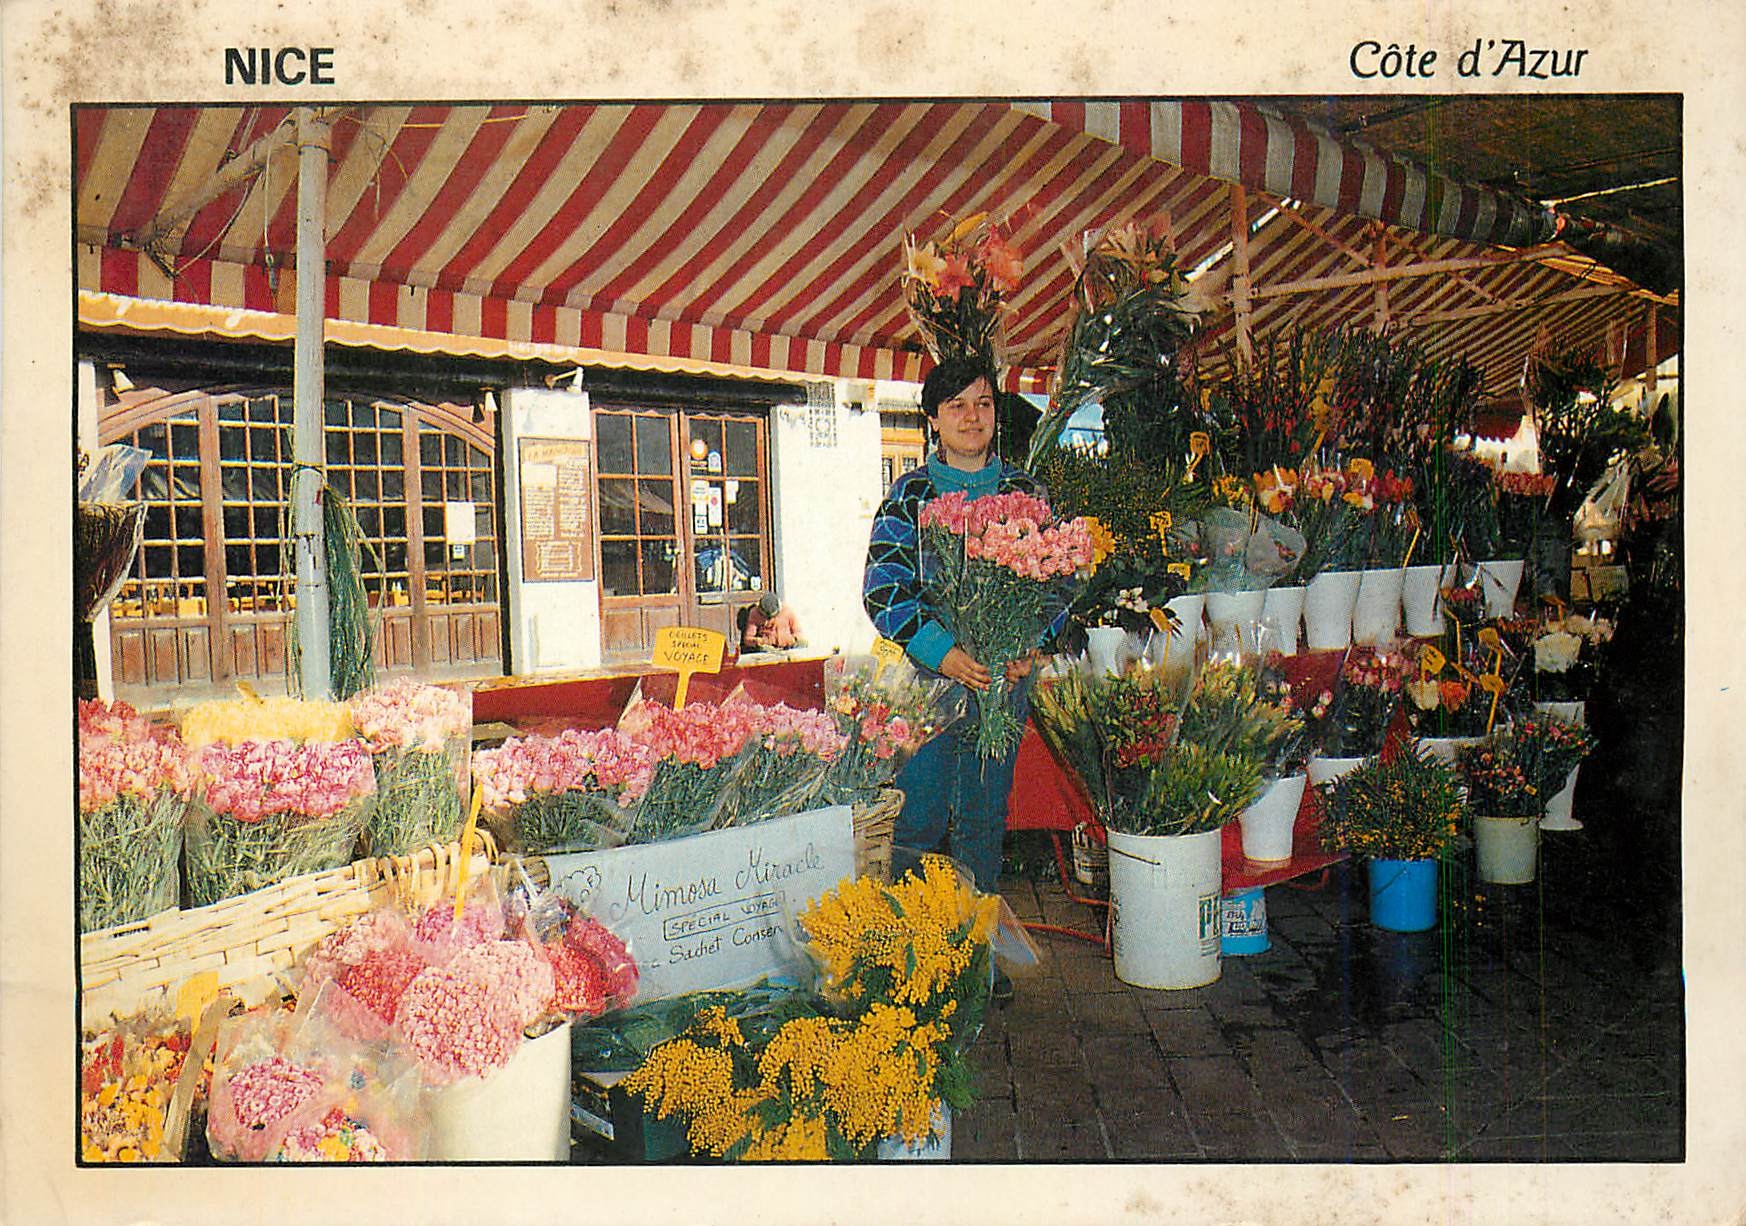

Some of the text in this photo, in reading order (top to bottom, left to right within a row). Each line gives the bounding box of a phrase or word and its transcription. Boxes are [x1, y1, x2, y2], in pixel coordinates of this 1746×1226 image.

[663, 651, 709, 664] VOYAGE
[609, 842, 825, 920] Mimosa Miracle
[670, 911, 730, 935] SPECIAL
[669, 936, 722, 964] Sachet
[732, 924, 784, 946] Conser
